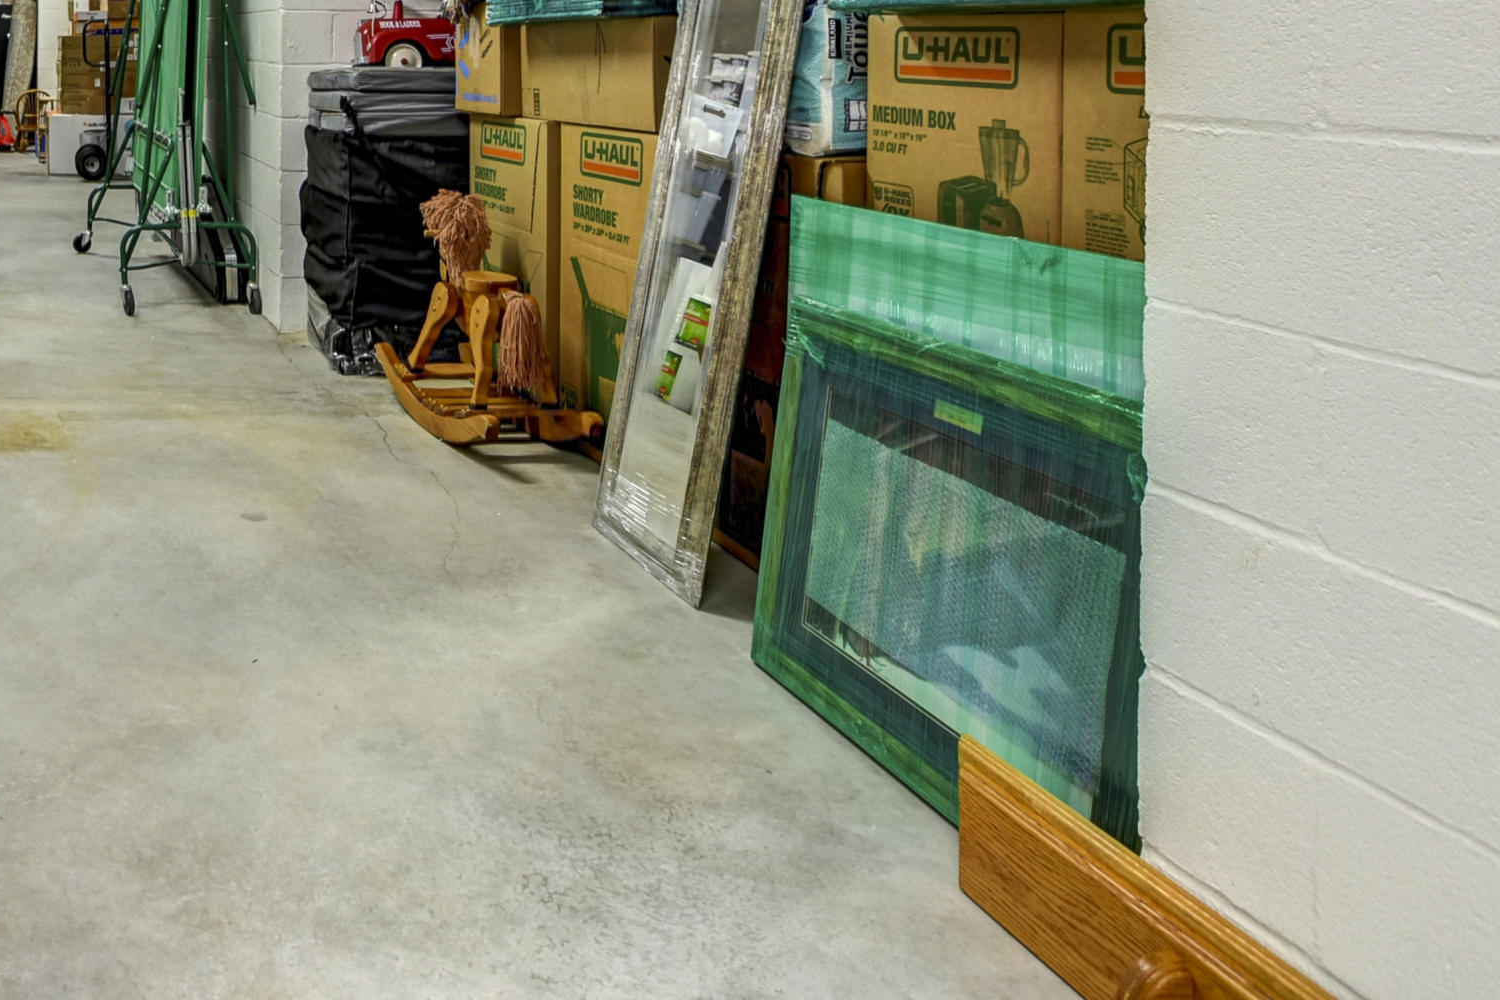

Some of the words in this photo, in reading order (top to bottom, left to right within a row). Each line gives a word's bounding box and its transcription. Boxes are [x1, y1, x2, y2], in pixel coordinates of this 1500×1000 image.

[829, 19, 837, 58] KIRKLAND
[902, 36, 1010, 64] U-HAUL
[872, 105, 924, 128] MEDIUM
[927, 110, 956, 130] BOX
[484, 127, 523, 150] U-HAUL
[872, 140, 884, 152] 3.0
[885, 142, 896, 154] CU
[897, 143, 908, 155] FT
[584, 139, 639, 167] U-HAUL
[474, 165, 497, 183] SHORTY
[474, 180, 507, 202] WARDROBE
[573, 184, 604, 206] SHORTY
[573, 201, 617, 228] WARDROBE
